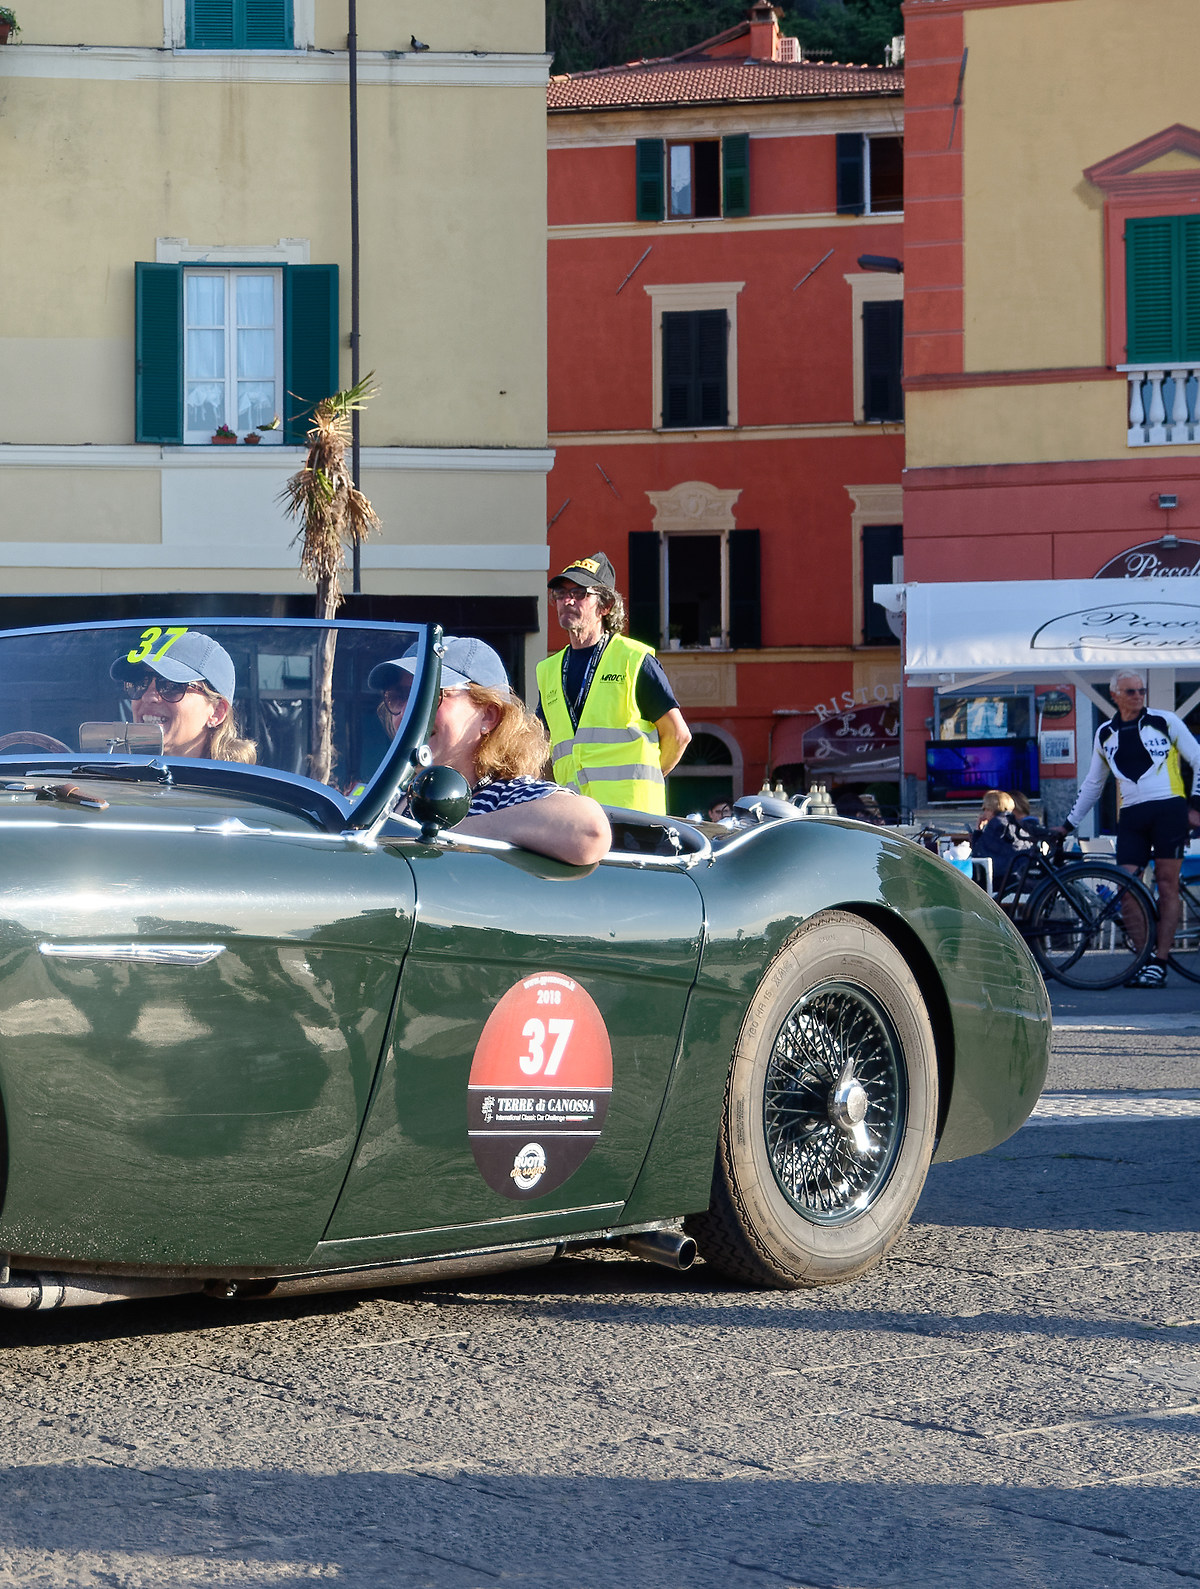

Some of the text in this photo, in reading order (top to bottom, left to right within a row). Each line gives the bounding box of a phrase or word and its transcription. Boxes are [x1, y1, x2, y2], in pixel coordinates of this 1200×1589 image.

[127, 627, 188, 663] 37
[537, 989, 561, 1005] 2018
[519, 1017, 574, 1075] 37
[497, 1098, 595, 1113] TERRE di CANOSSA
[495, 1113, 566, 1123] International Classic Car Challenge
[522, 1165, 547, 1180] sogno
